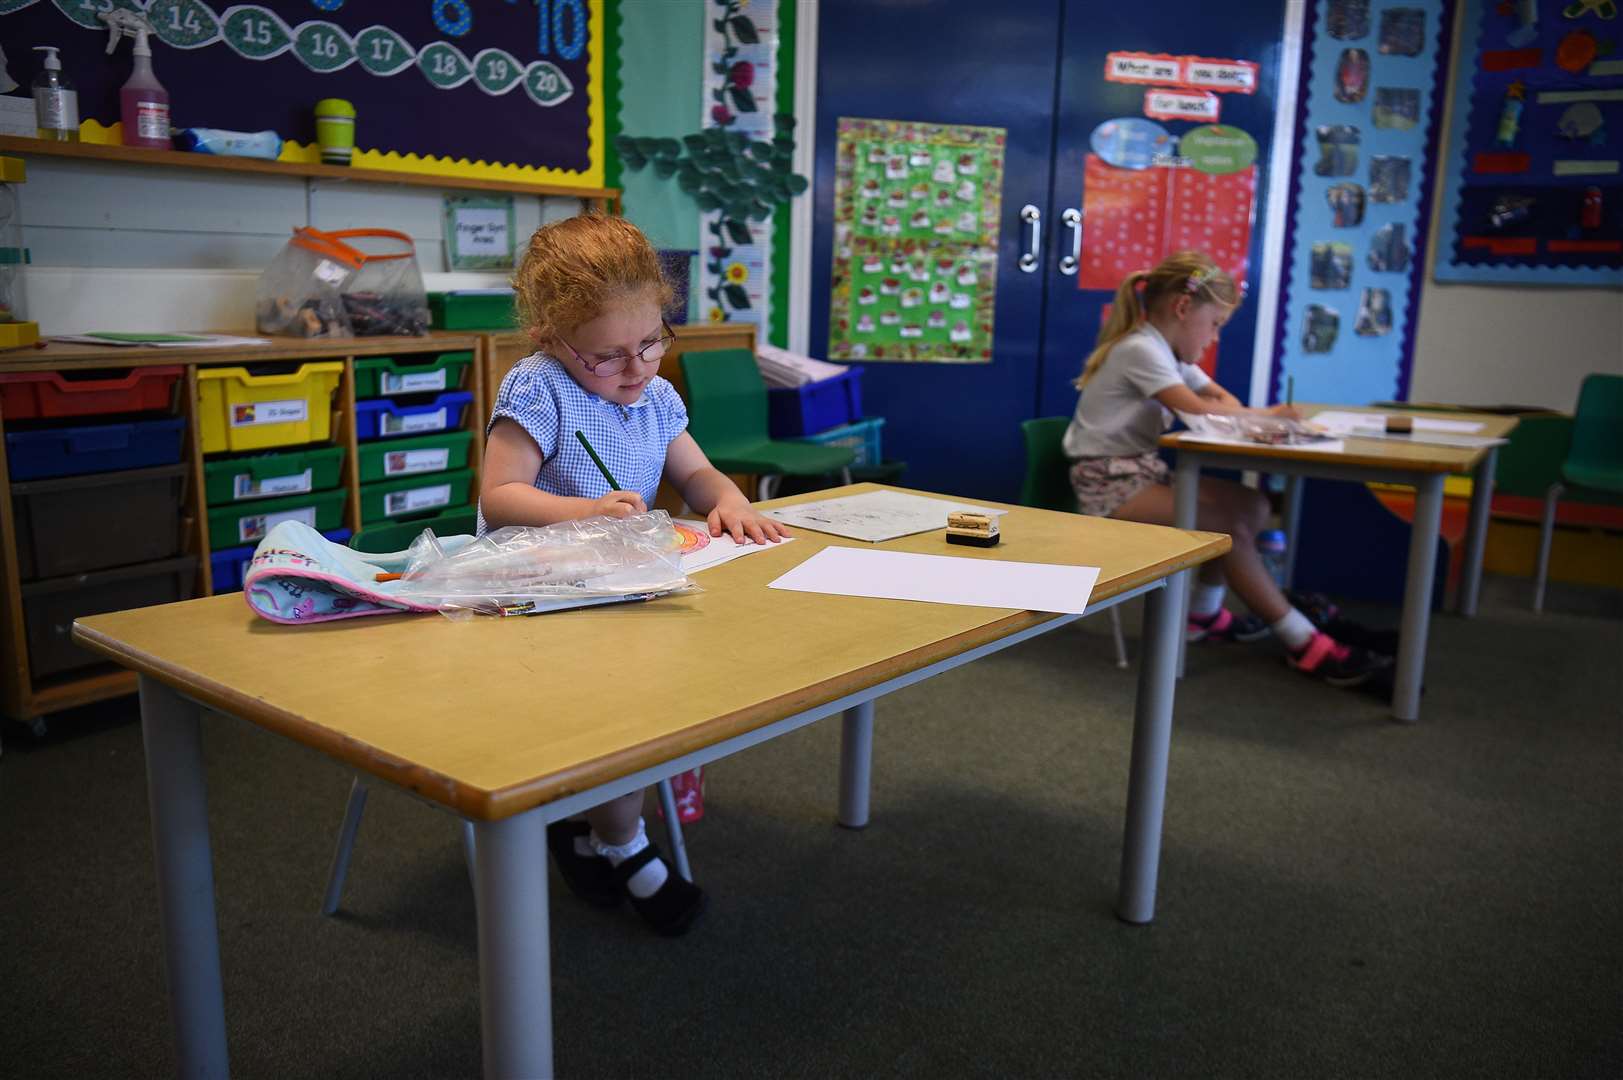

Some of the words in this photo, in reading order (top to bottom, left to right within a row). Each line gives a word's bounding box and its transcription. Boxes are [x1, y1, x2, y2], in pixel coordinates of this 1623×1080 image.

[168, 5, 201, 34] 14
[242, 18, 272, 45] 15
[311, 32, 339, 58] 16
[370, 37, 395, 61] 17
[432, 52, 457, 76] 18
[486, 58, 508, 81] 19
[535, 70, 558, 93] 20
[535, 0, 586, 60] 10
